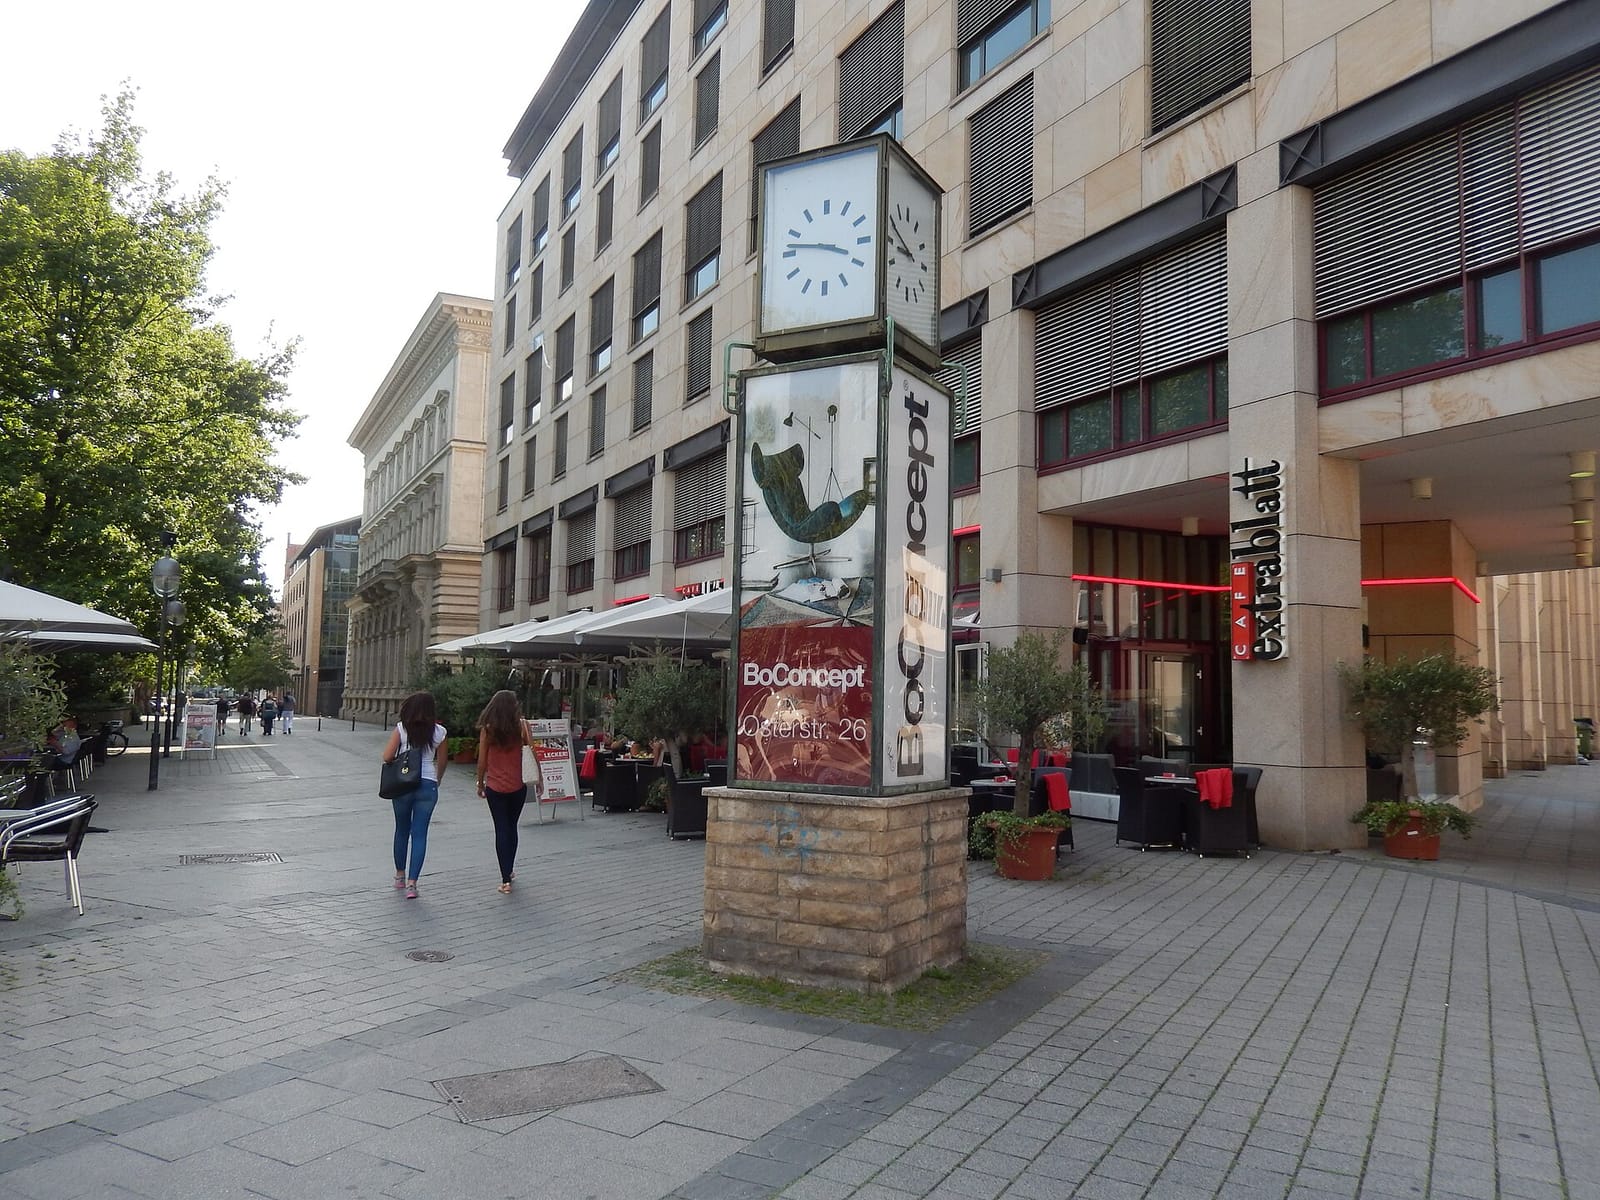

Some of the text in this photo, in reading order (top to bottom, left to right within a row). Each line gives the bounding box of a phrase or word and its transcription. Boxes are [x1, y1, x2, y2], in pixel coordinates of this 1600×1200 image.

[1231, 457, 1285, 661] extrablatt
[1234, 566, 1247, 656] CAFE
[743, 662, 865, 692] BoConcept
[743, 714, 868, 741] Osterstr. 26
